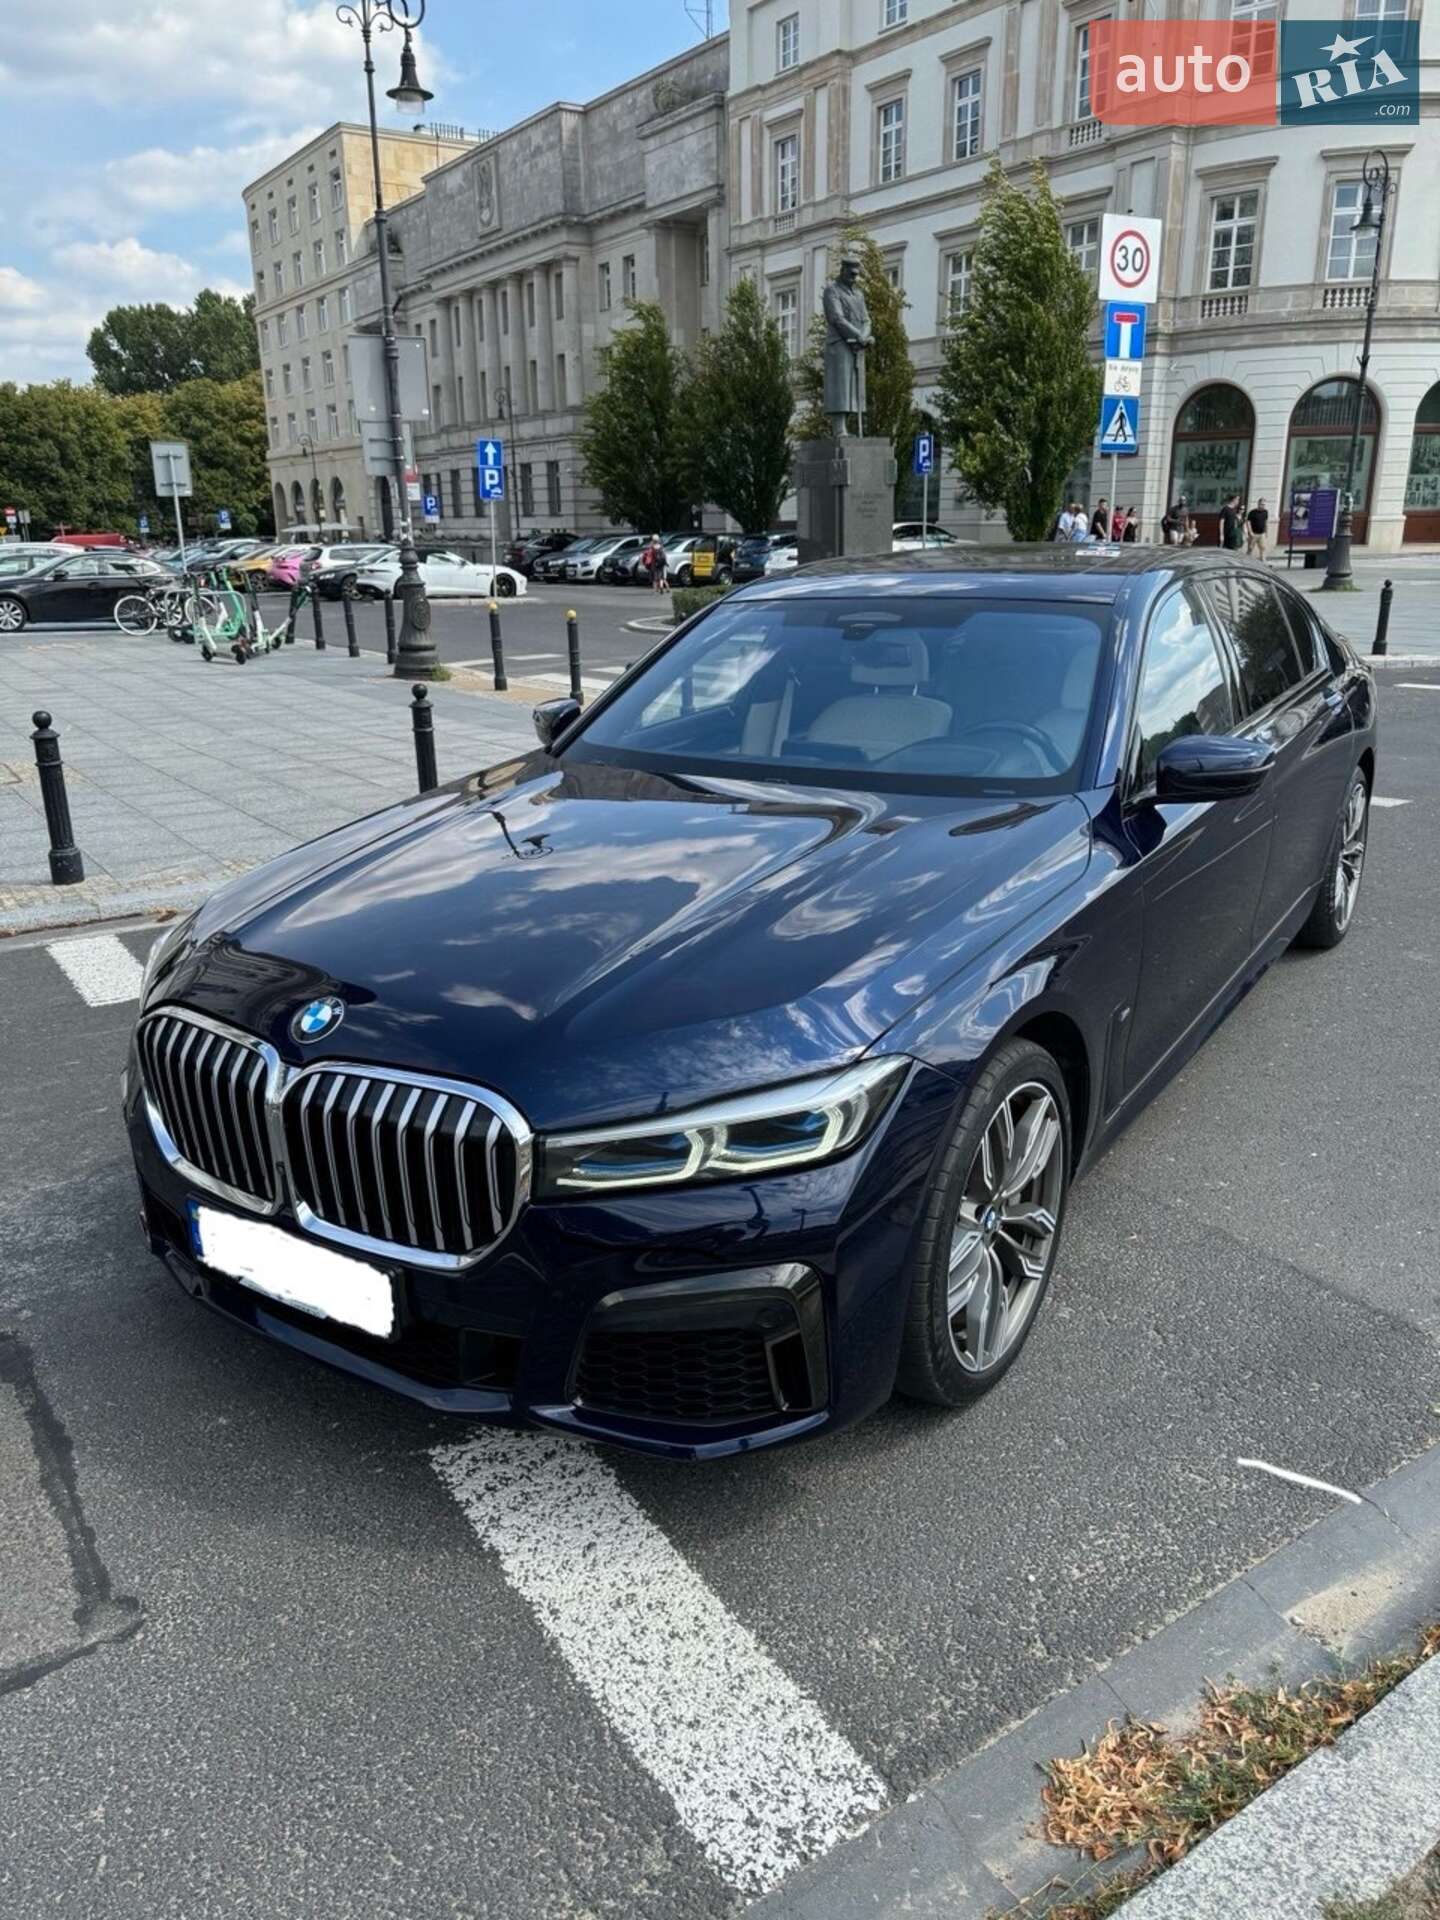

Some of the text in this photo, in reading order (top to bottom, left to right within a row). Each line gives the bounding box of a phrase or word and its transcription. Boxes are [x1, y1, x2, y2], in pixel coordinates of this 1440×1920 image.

[1116, 244, 1144, 273] 30
[919, 438, 930, 464] P
[485, 469, 499, 490] P
[426, 496, 436, 510] P
